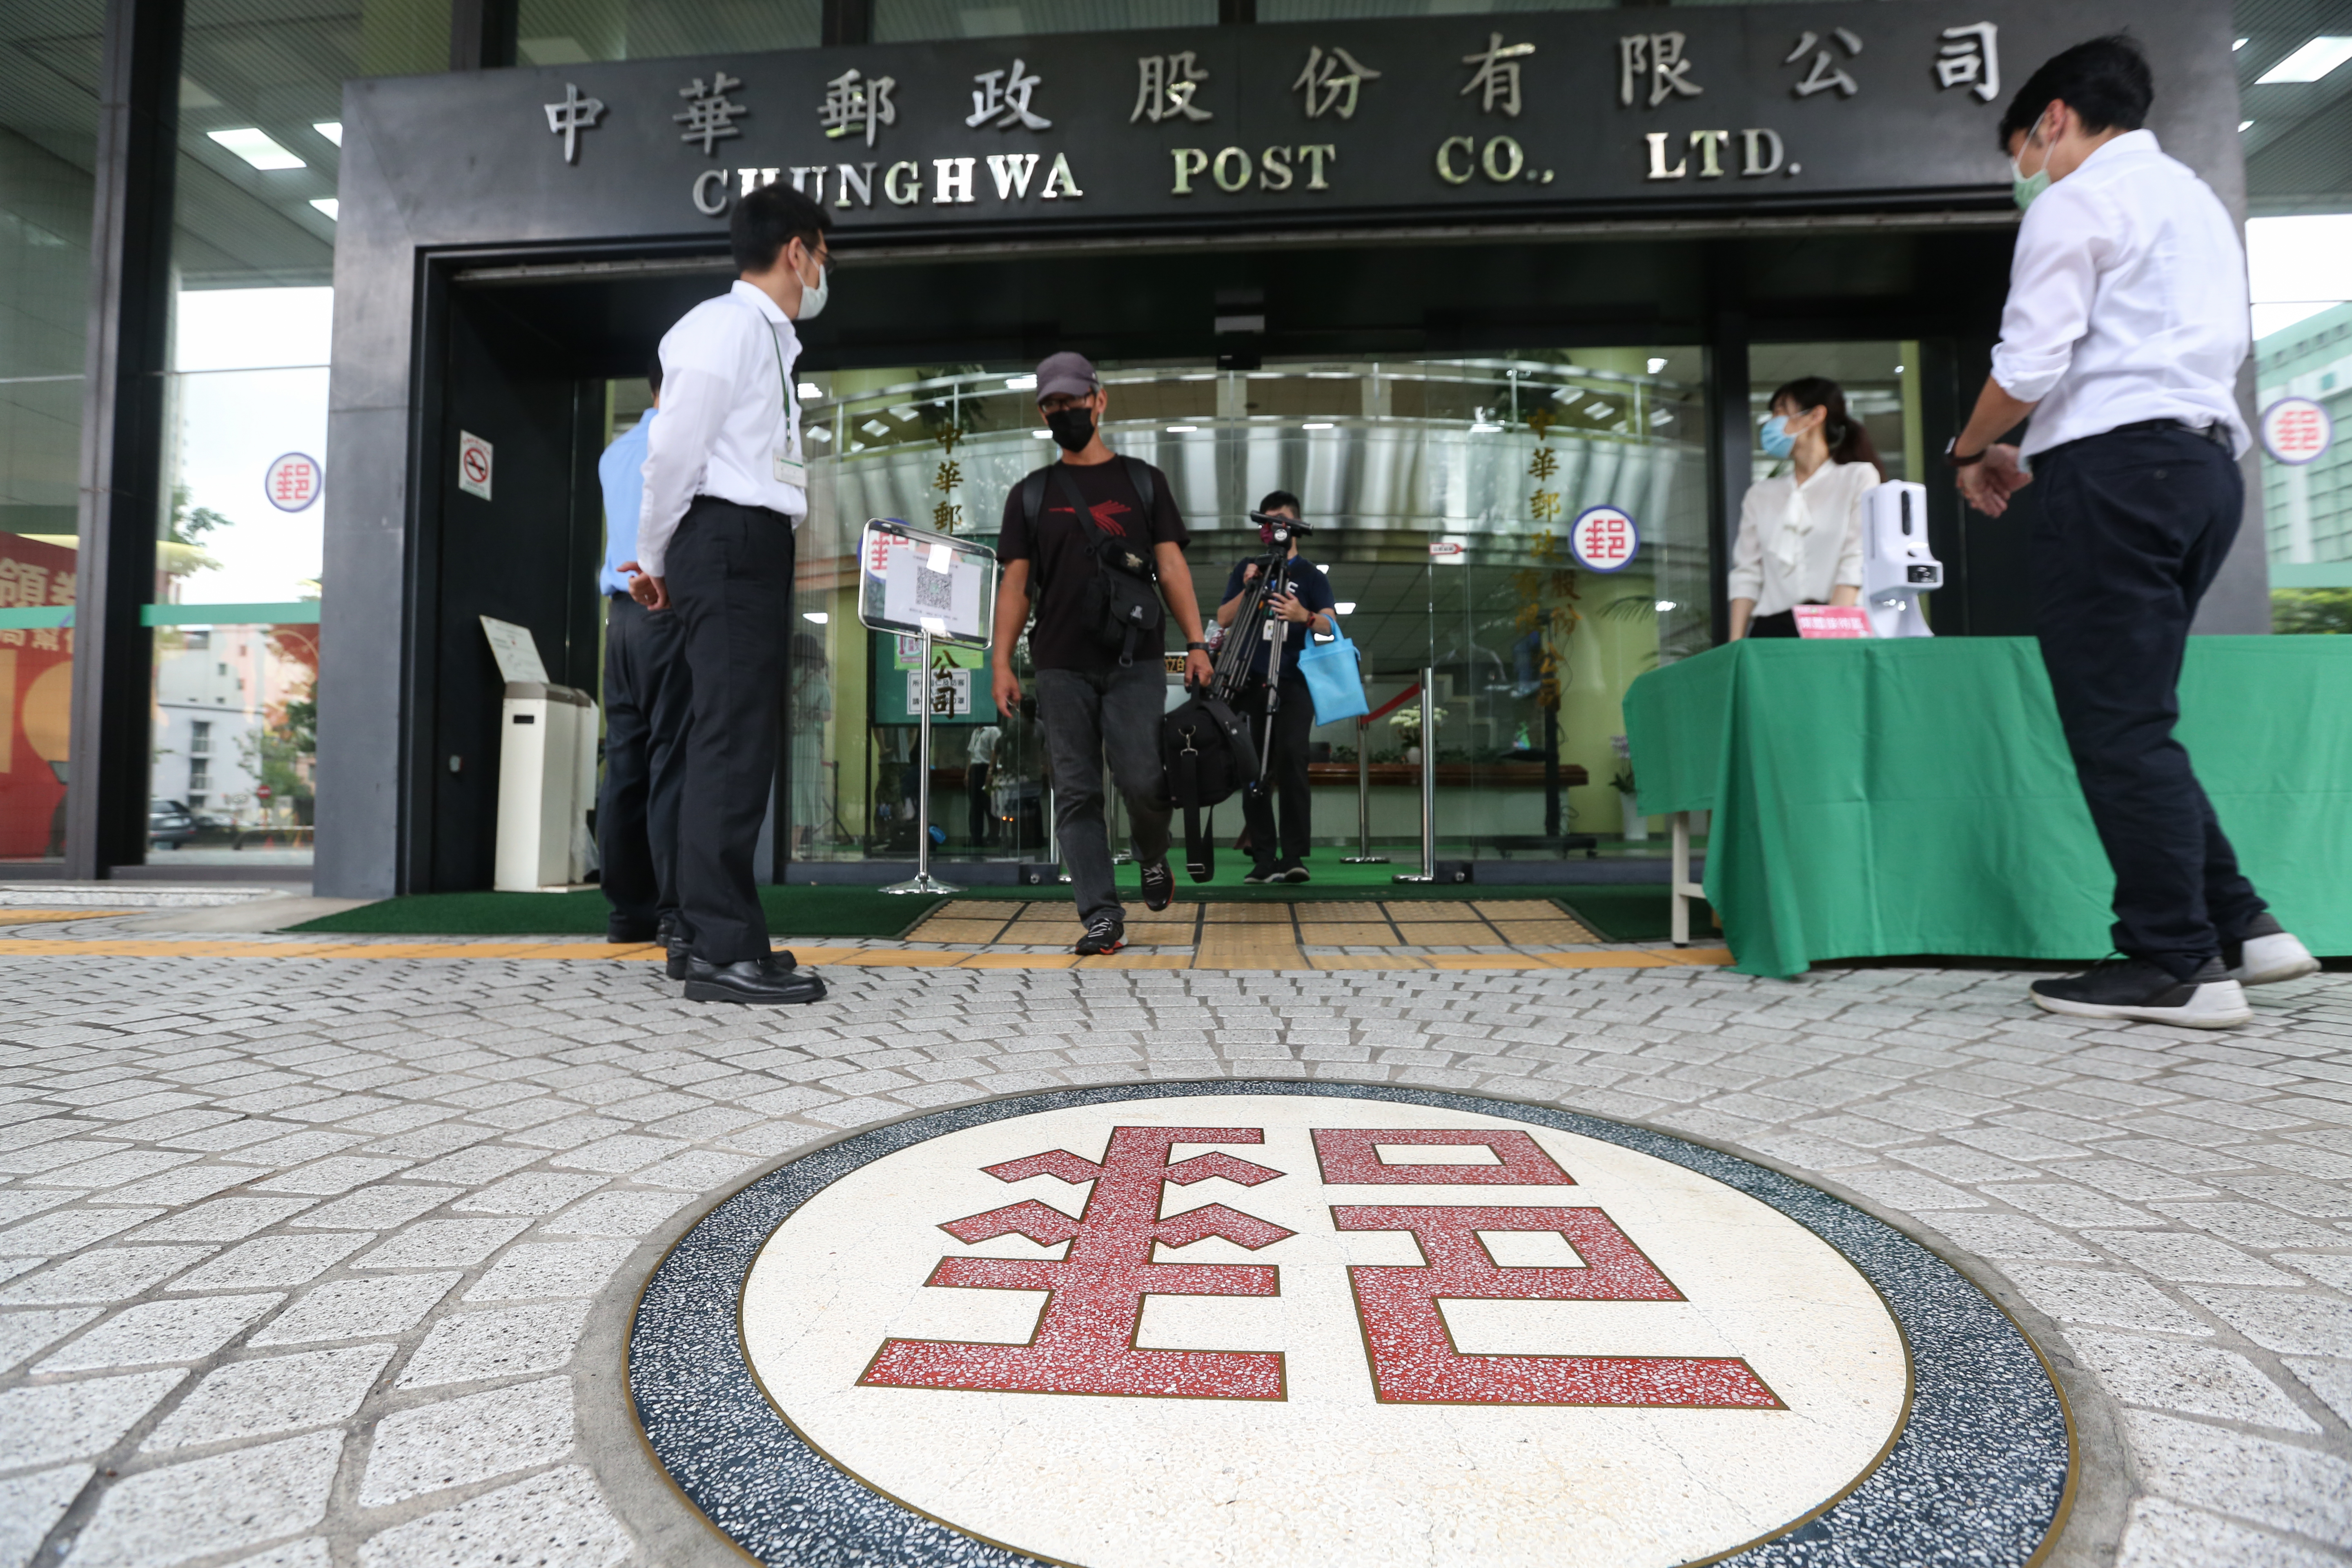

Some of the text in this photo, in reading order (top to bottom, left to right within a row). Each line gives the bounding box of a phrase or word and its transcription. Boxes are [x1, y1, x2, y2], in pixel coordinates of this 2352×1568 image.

[544, 21, 1999, 163] 中華郵政股份有限公司
[1170, 144, 1336, 194] POST
[1436, 136, 1555, 185] CO.,
[1645, 128, 1801, 179] LTD.
[277, 464, 310, 500] 郵
[1585, 518, 1626, 559] 郵
[931, 650, 961, 719] 公司
[854, 1124, 1791, 1410] 郵
